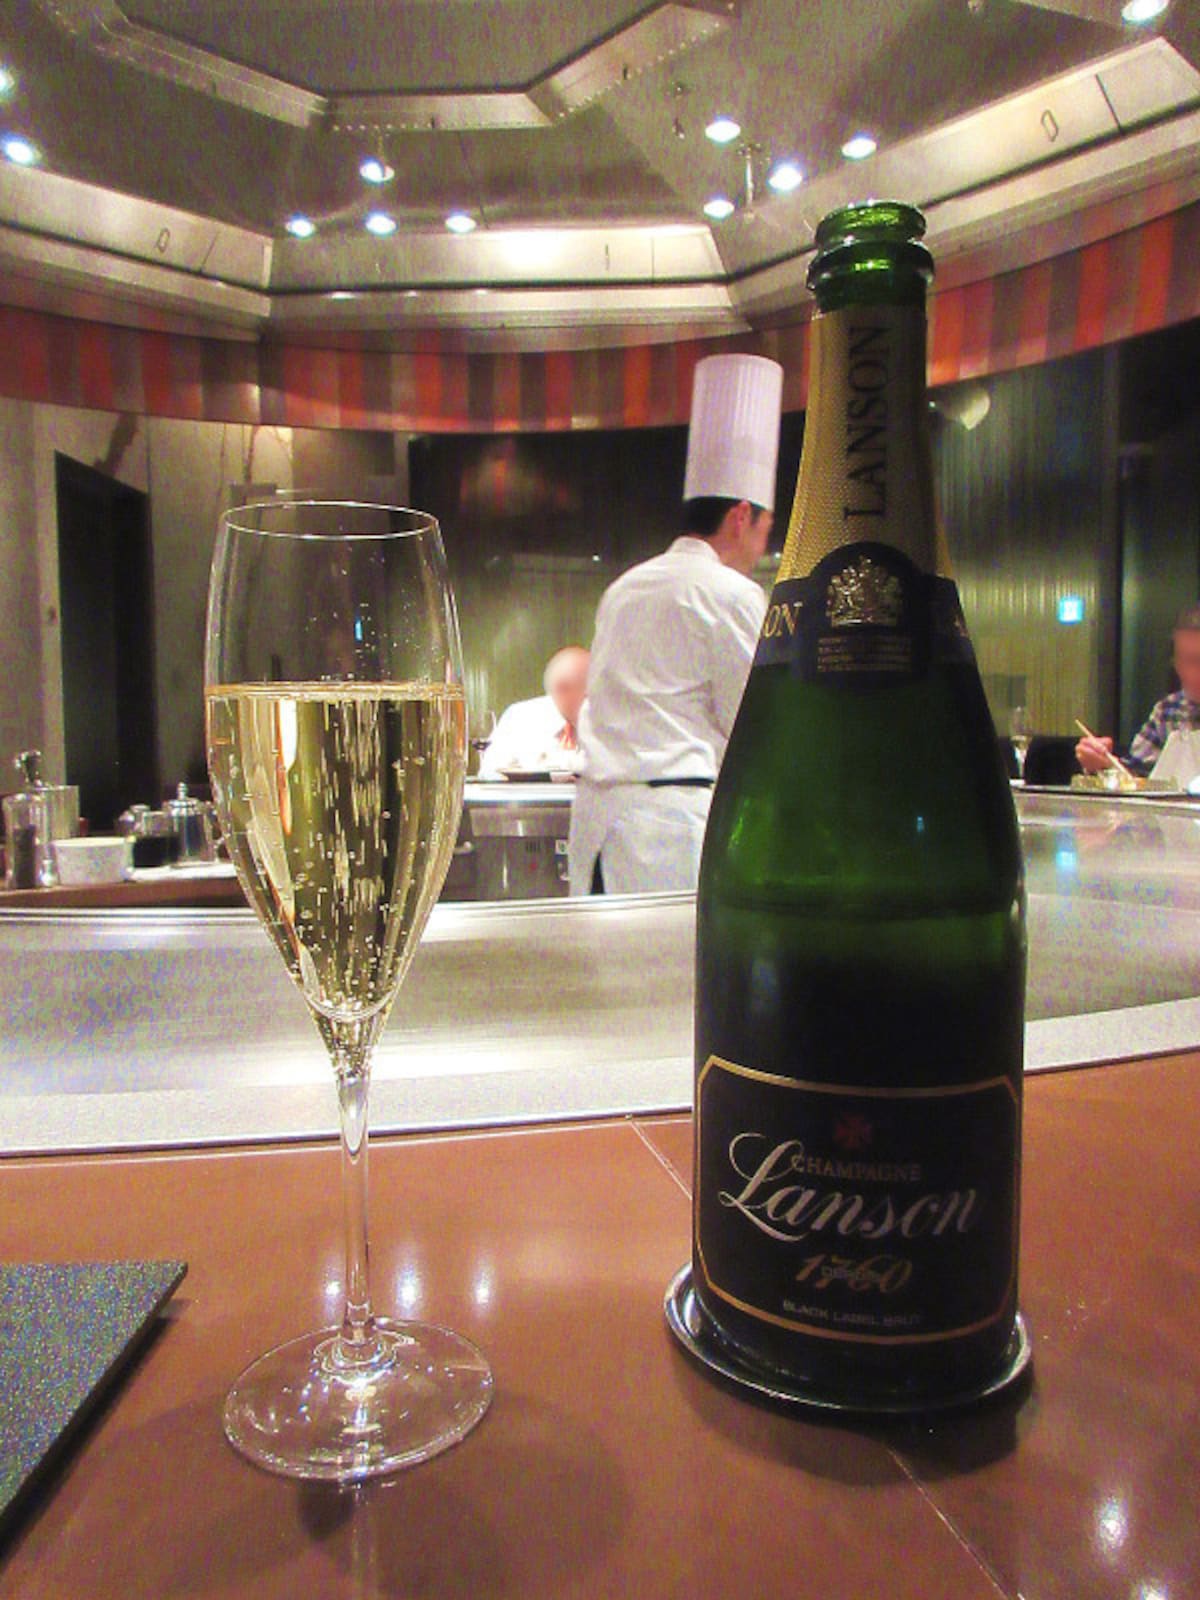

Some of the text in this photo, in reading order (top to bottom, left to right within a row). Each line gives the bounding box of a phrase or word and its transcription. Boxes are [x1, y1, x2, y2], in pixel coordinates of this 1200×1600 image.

[844, 325, 890, 520] LANSON
[718, 1132, 977, 1242] Lanson
[790, 1154, 922, 1182] CHAMPAGNE
[795, 1252, 913, 1293] 1760
